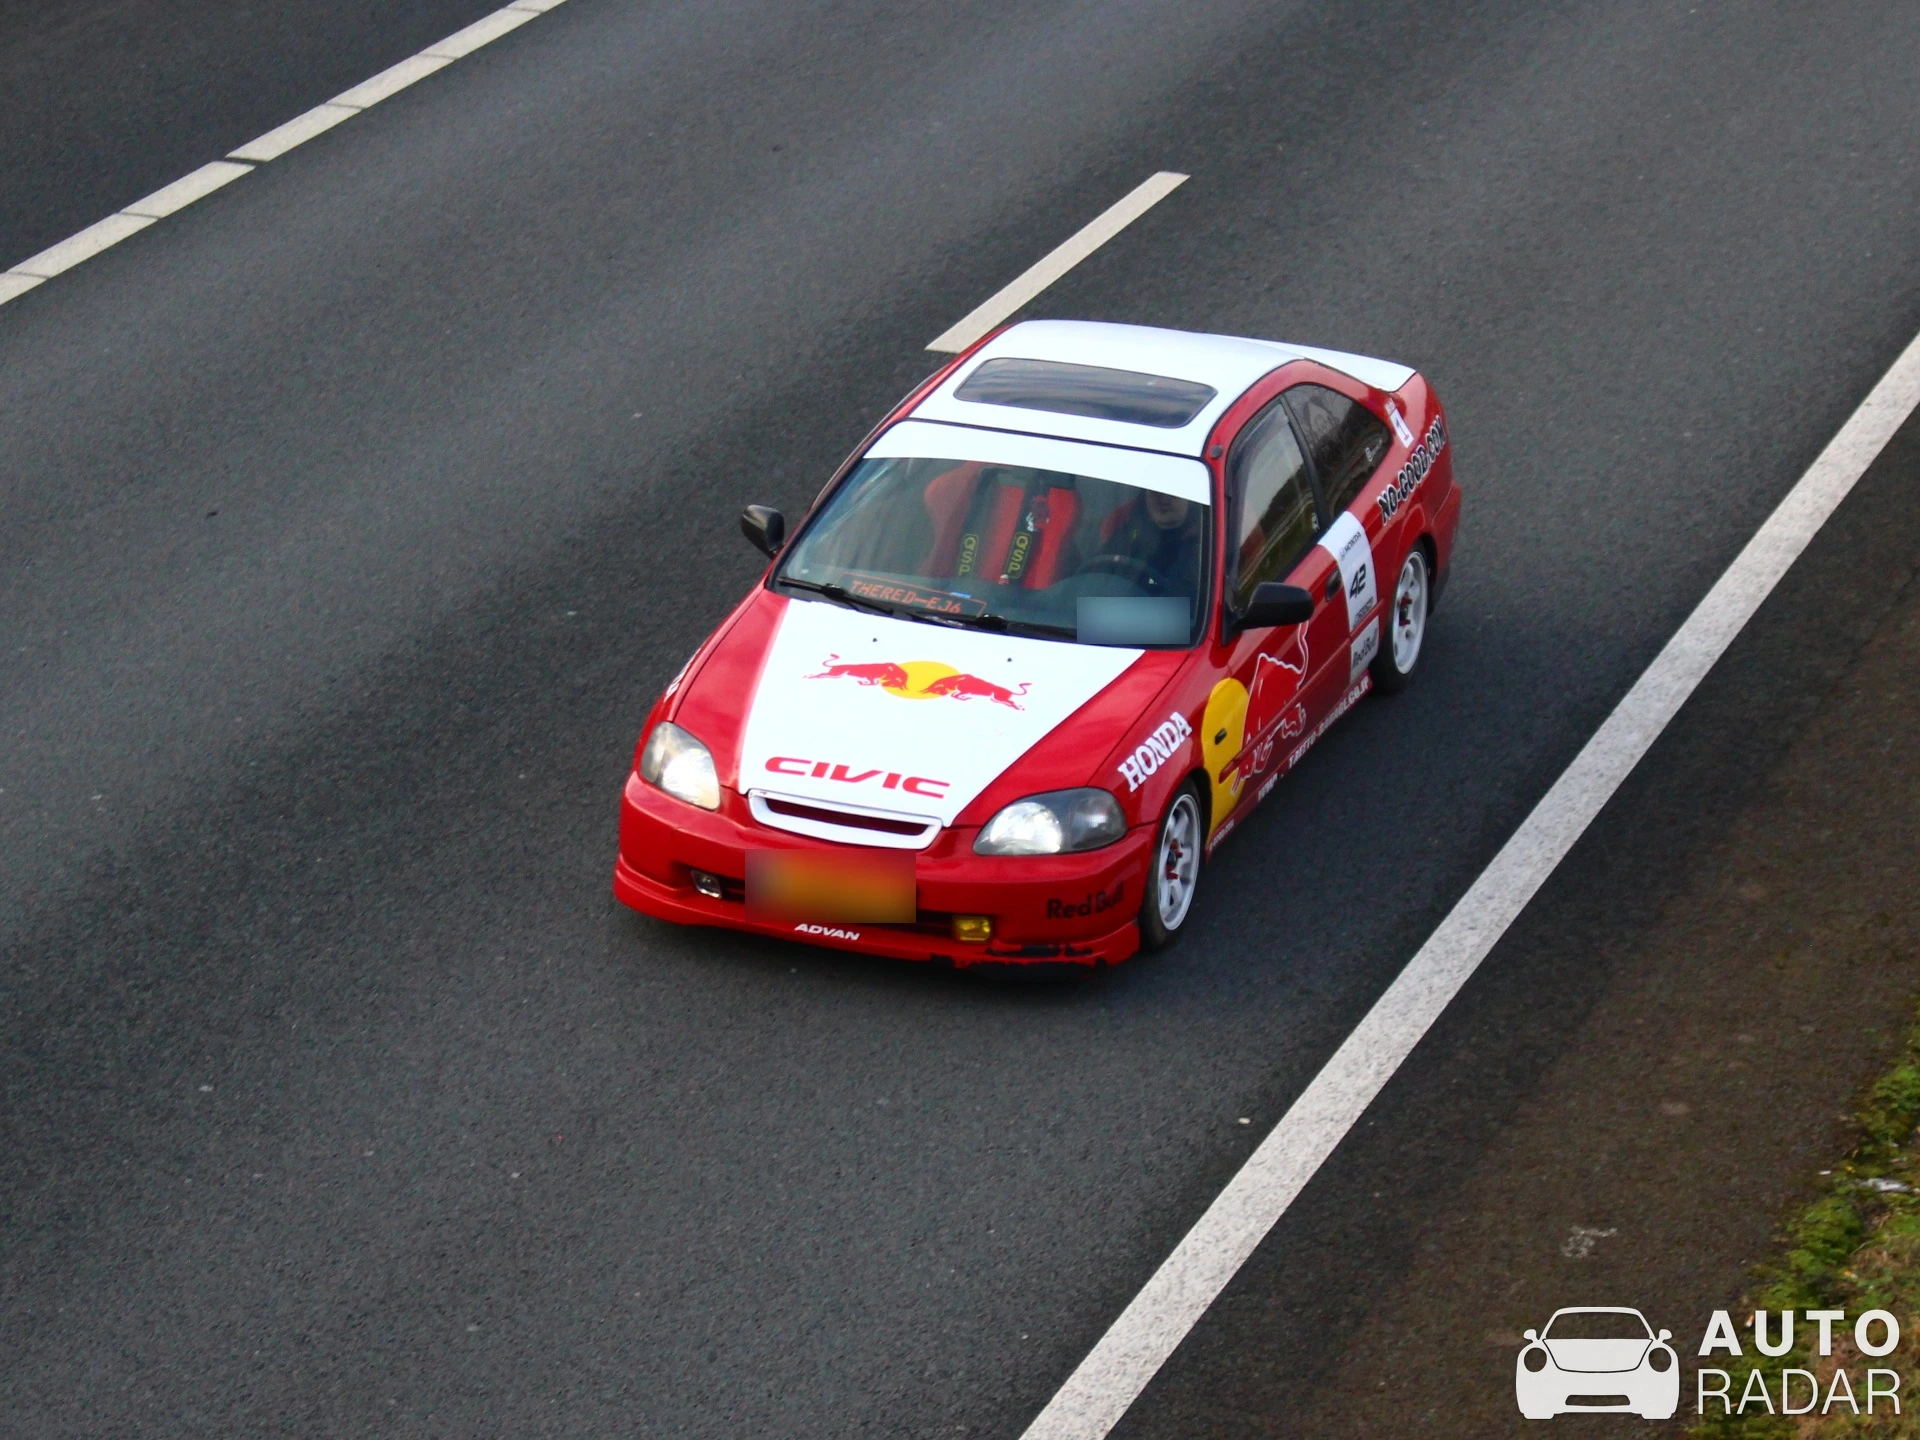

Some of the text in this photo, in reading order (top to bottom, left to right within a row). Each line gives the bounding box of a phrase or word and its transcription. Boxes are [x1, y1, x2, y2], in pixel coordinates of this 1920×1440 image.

[958, 536, 977, 576] QSP
[1008, 535, 1029, 574] QSP
[1349, 563, 1367, 600] 42
[1117, 711, 1194, 793] HONDA
[765, 756, 950, 799] CIVIC
[1046, 893, 1092, 919] Red
[794, 923, 860, 941] ADVAN
